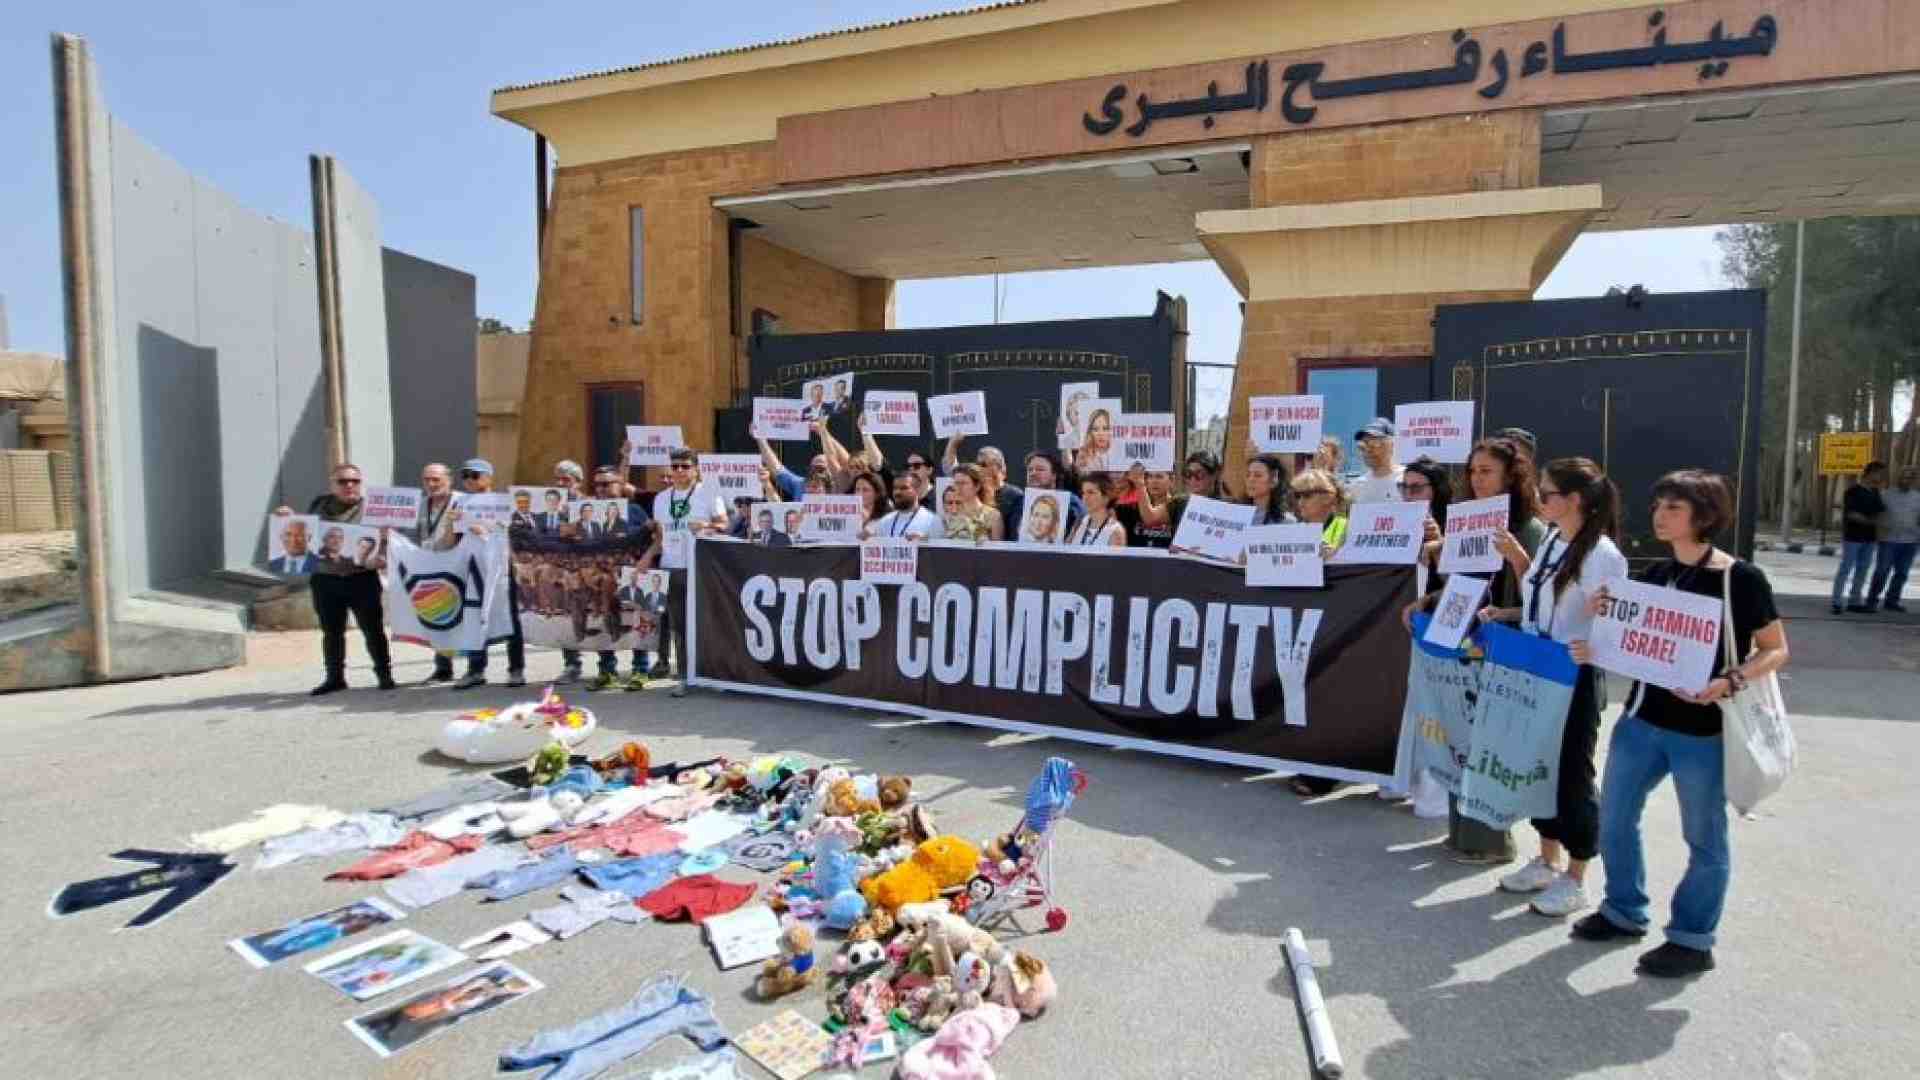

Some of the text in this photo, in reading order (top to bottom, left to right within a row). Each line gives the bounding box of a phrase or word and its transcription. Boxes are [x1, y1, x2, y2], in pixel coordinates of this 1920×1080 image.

[1519, 9, 1778, 80] ميناء
[1281, 28, 1509, 124] رفح
[1253, 407, 1320, 420] STOP GENOCIDE
[1132, 425, 1172, 437] GENOCIDE
[1269, 424, 1302, 440] NOW!
[1126, 442, 1155, 458] NOW!
[701, 463, 758, 473] STOP GENOCIDE
[719, 475, 748, 488] NOW!
[818, 518, 847, 531] NOW!
[1374, 516, 1395, 531] END
[1447, 510, 1505, 533] STOP GENOCIDE
[1355, 534, 1411, 548] APARTHEID
[1458, 534, 1489, 557] NOW!
[1598, 597, 1716, 644] STOP ARMING
[740, 575, 1324, 727] STOP COMPLICITY
[1620, 628, 1677, 664] ISRAEL
